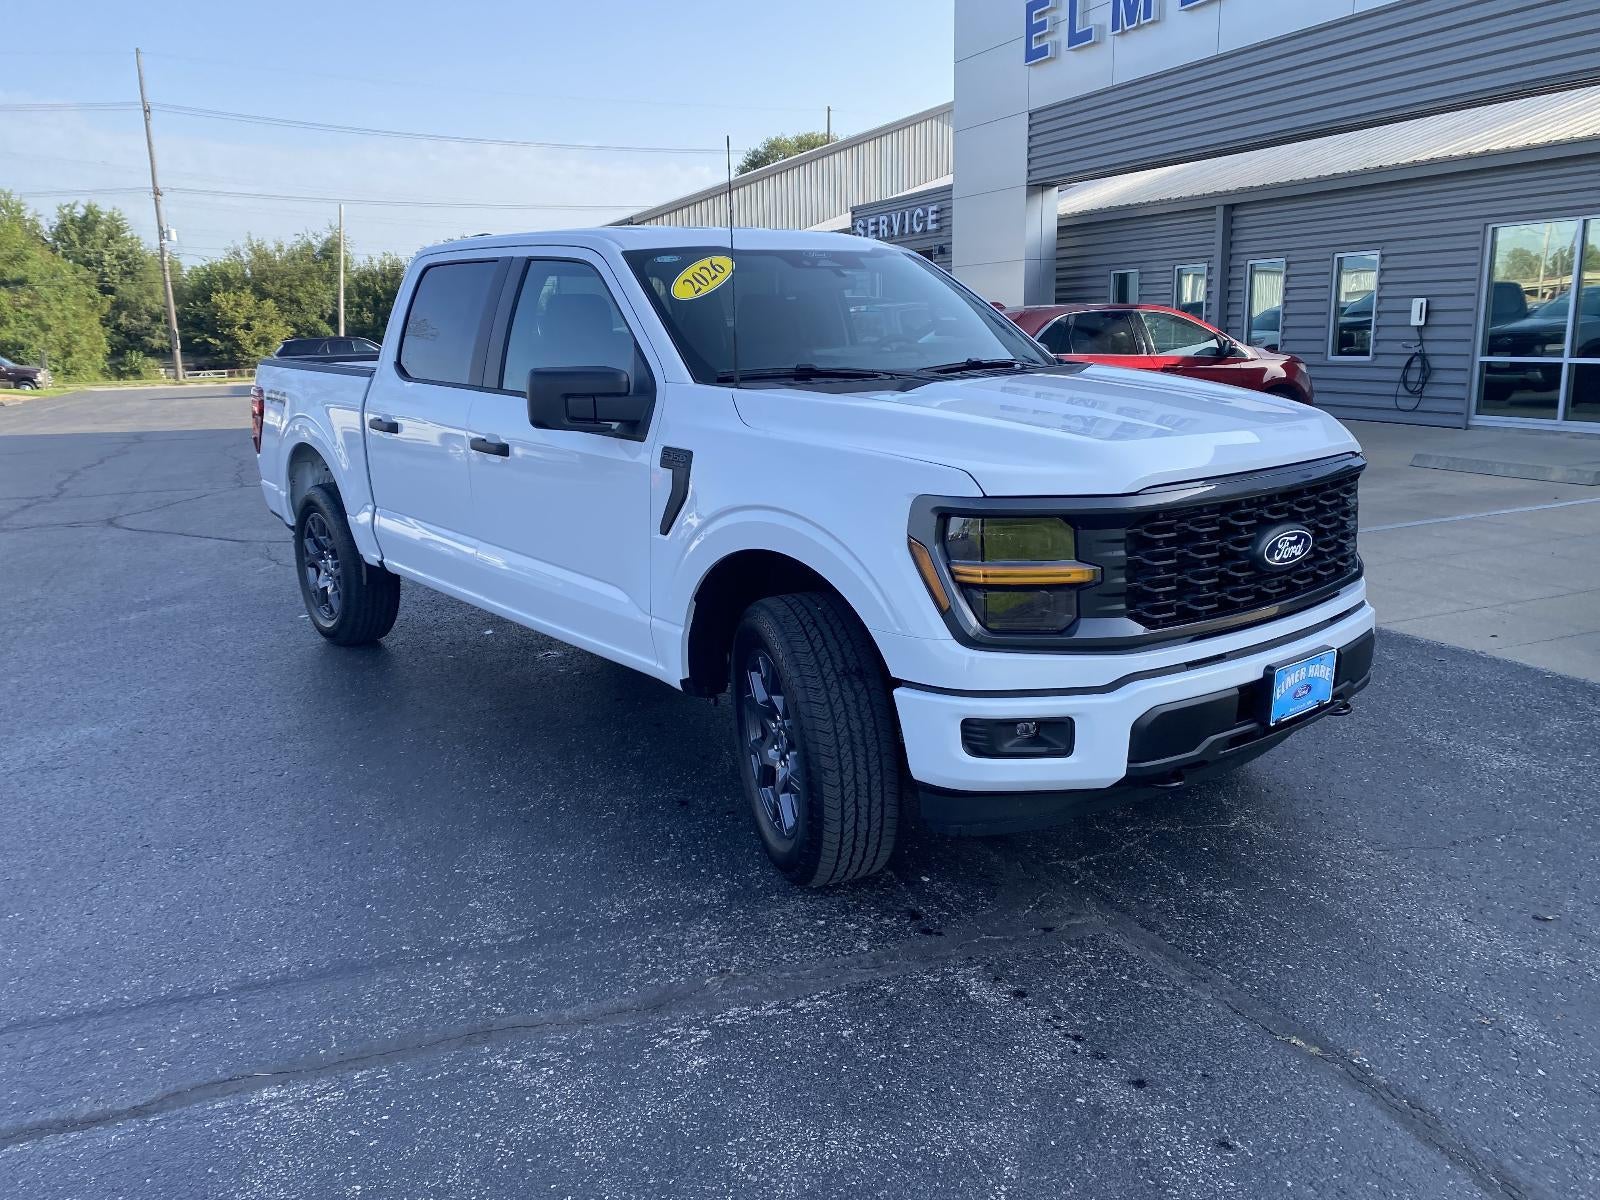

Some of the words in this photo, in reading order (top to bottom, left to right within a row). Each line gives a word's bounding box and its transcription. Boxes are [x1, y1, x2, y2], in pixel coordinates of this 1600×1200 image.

[1024, 0, 1221, 65] EL
[855, 204, 939, 238] SERVICE
[682, 259, 726, 295] 2026
[1273, 534, 1305, 561] Ford
[1276, 667, 1306, 700] ELMER
[1308, 664, 1331, 681] HARE
